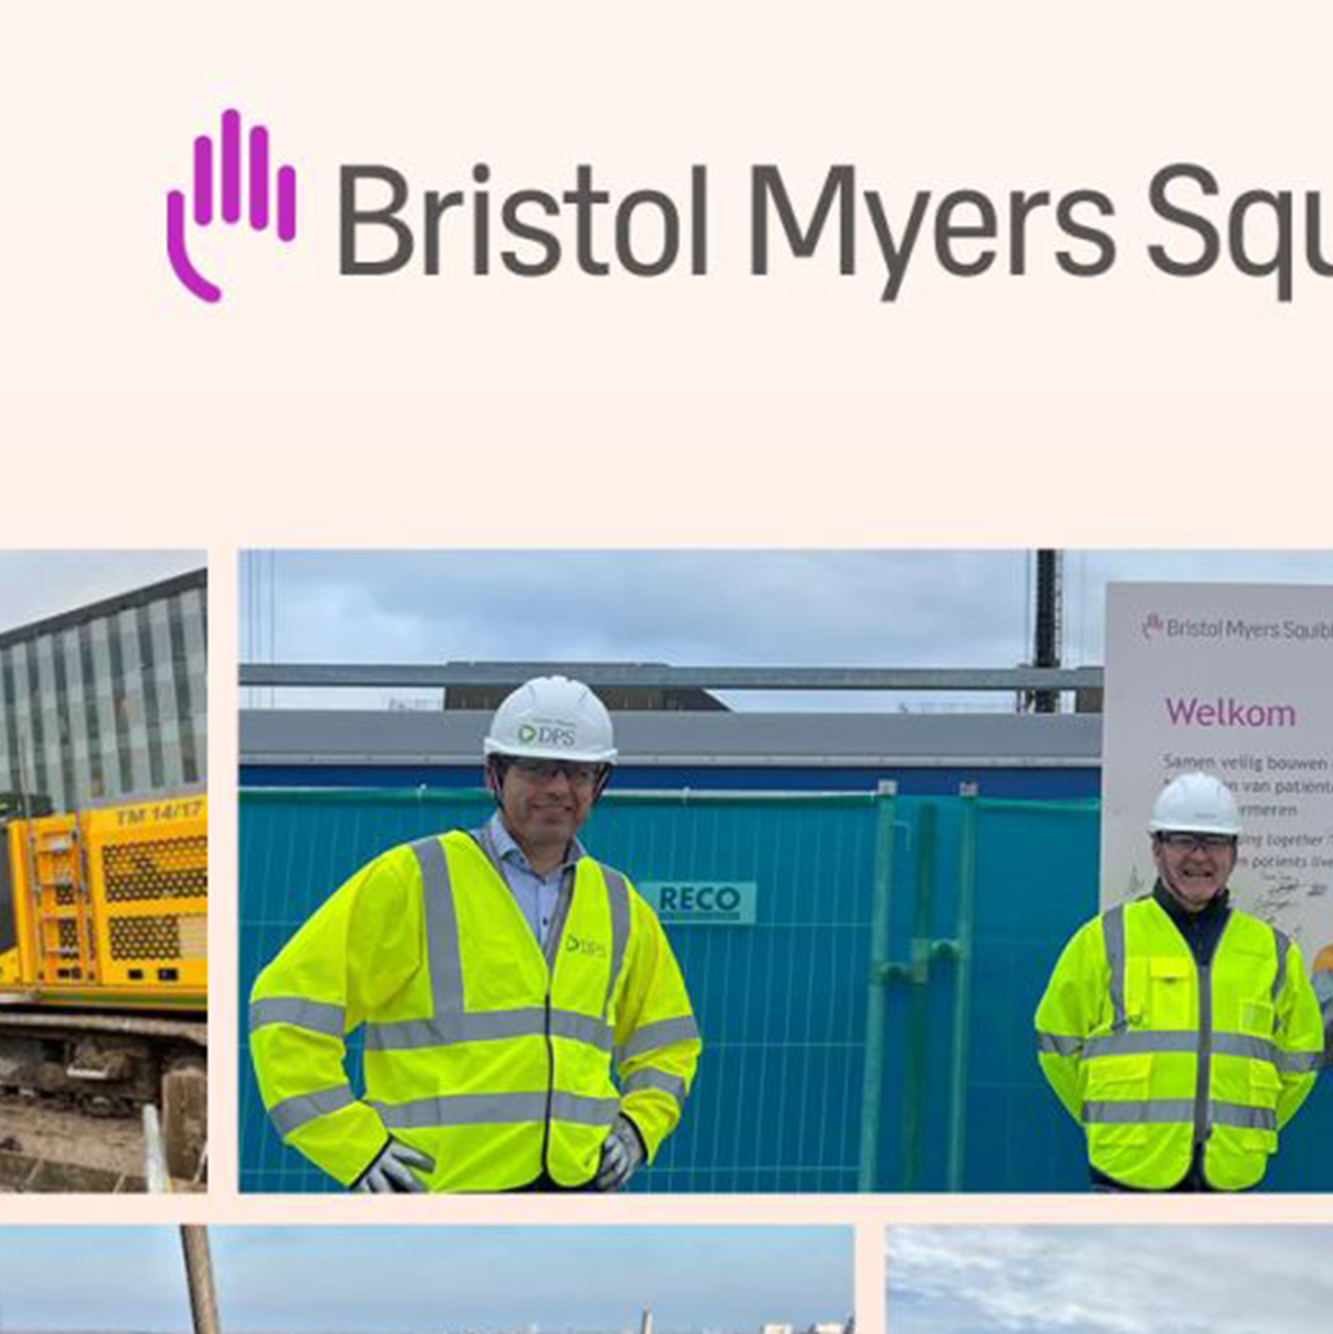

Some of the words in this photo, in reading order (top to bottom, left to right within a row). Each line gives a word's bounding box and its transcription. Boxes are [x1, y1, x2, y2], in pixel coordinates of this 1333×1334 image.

[1166, 618, 1224, 638] Bristol
[1225, 620, 1281, 640] Myers
[1165, 697, 1296, 727] Welkom
[538, 726, 577, 747] DPS
[1162, 753, 1216, 768] Samen
[1220, 753, 1264, 773] veilig
[1267, 755, 1328, 771] bouwen
[1243, 781, 1271, 793] van
[1266, 833, 1325, 848] together
[1252, 854, 1308, 871] patients
[659, 886, 741, 911] RECO
